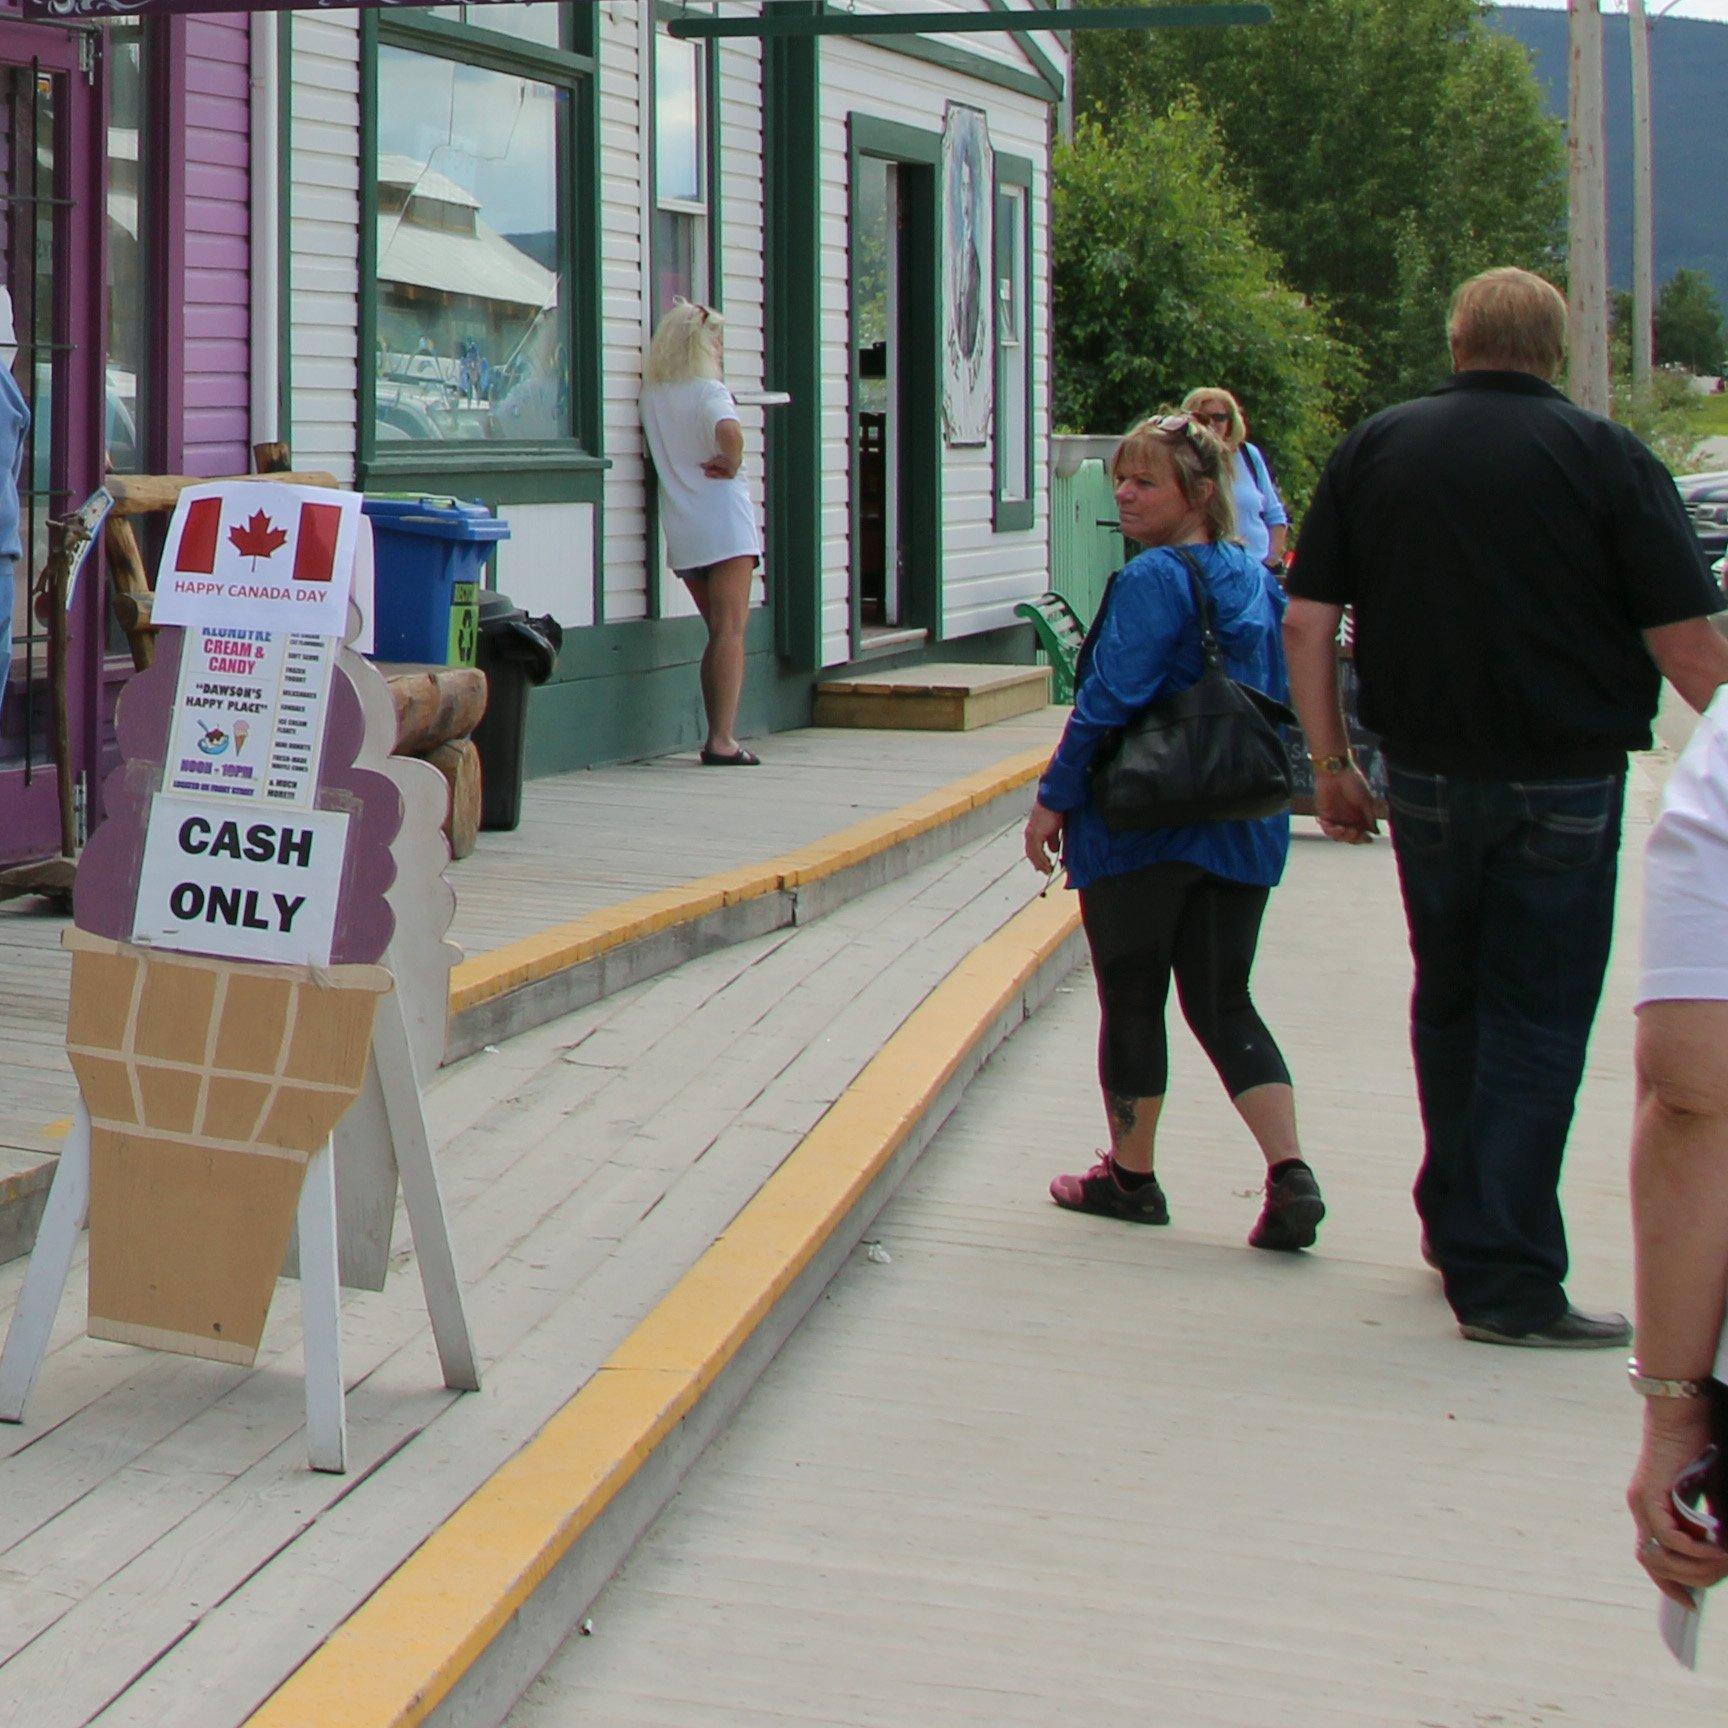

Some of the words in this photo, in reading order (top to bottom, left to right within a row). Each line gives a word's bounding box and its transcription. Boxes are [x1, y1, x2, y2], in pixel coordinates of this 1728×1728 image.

[174, 581, 223, 597] HAPPY
[228, 584, 291, 600] CANADA
[296, 589, 328, 603] DAY
[204, 639, 253, 657] CREAM
[255, 646, 265, 659] &
[209, 657, 256, 674] CANDY
[186, 696, 224, 710] HAPPY
[180, 759, 213, 775] NOON
[222, 763, 253, 780] 10PM
[178, 816, 314, 868] CASH
[170, 882, 306, 933] ONLY
